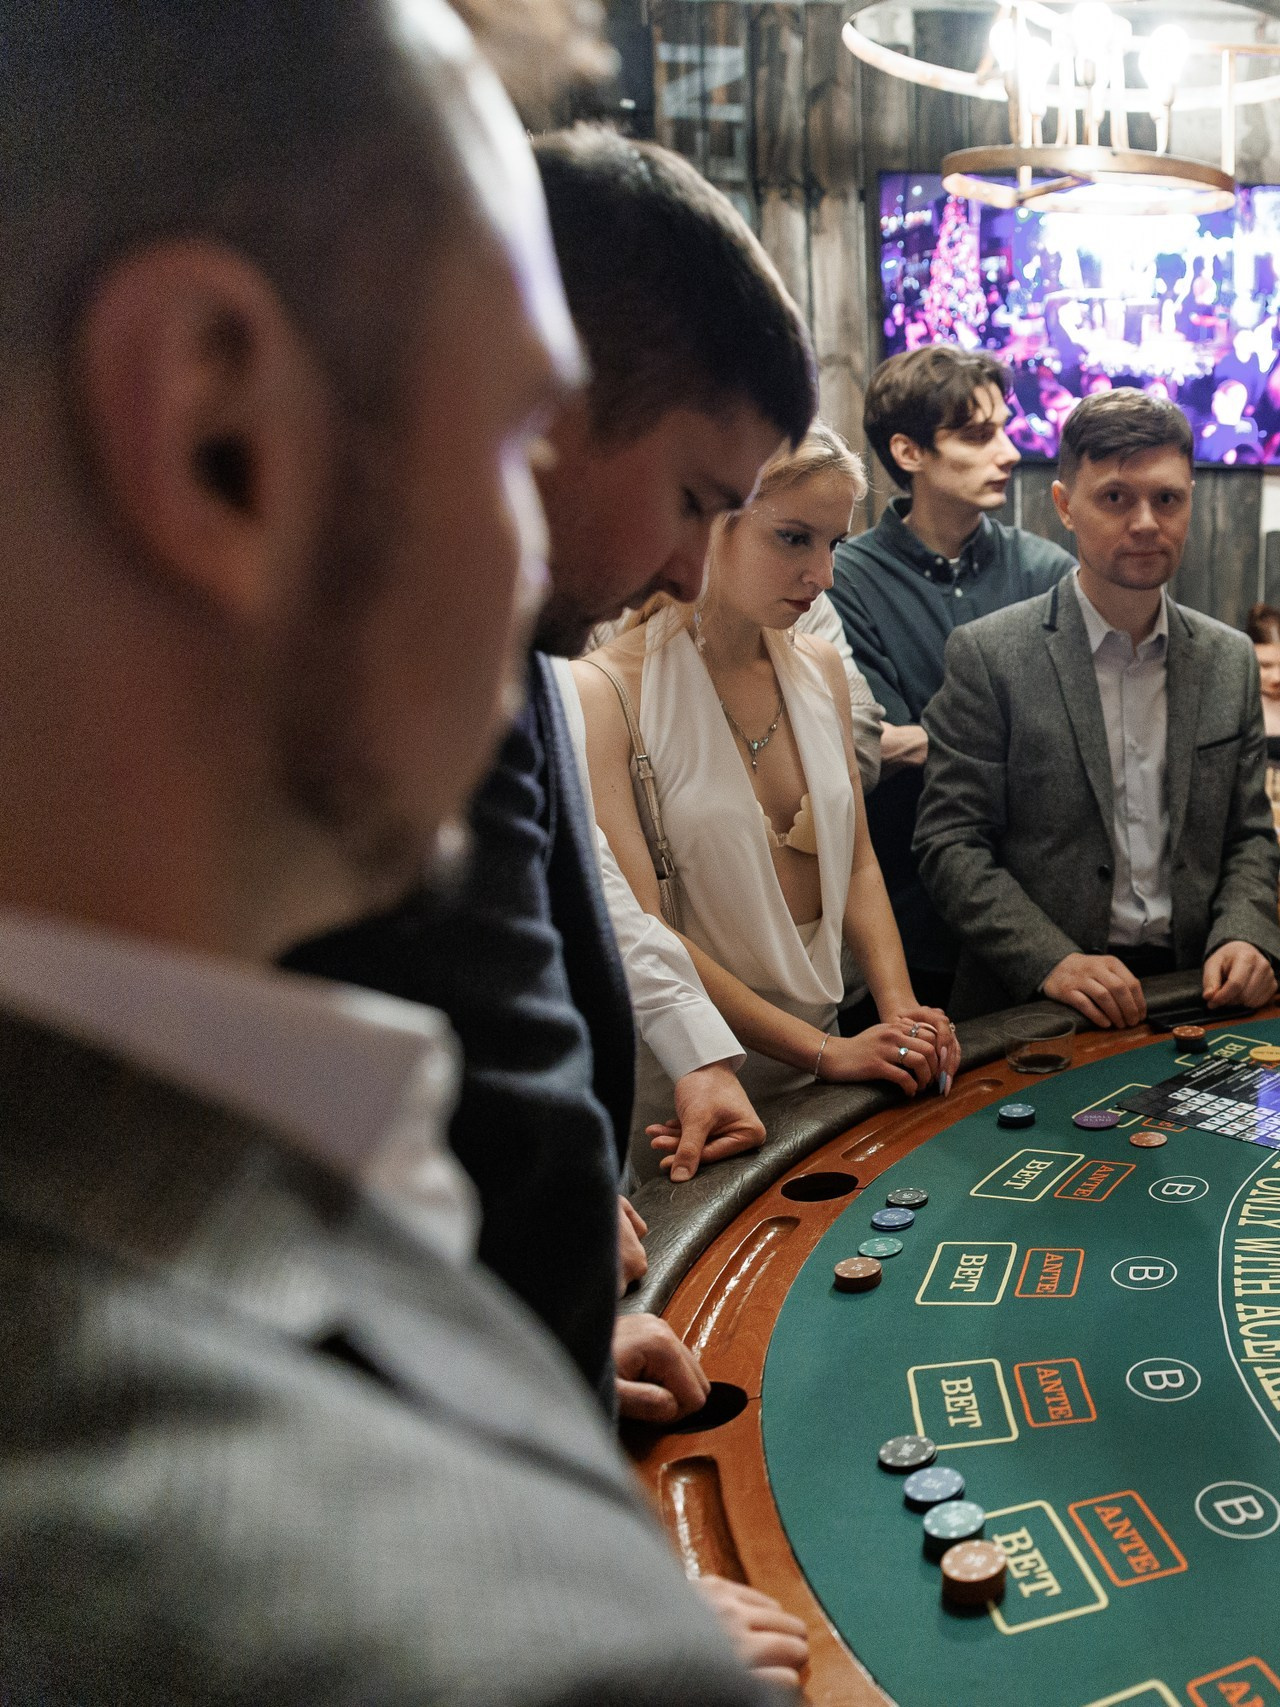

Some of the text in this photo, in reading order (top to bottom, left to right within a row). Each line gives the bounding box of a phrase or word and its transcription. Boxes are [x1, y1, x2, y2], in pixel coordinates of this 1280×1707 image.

[1204, 1043, 1248, 1059] BE
[1003, 1158, 1054, 1190] BET
[1072, 1164, 1116, 1197] ANTE
[1161, 1182, 1197, 1196] B
[948, 1253, 988, 1292] BET
[1035, 1252, 1064, 1294] ANTE
[1128, 1266, 1165, 1281] B
[1036, 1366, 1074, 1420] ANTE
[1143, 1369, 1185, 1391] B
[940, 1376, 983, 1428] BET
[1212, 1494, 1265, 1526] B
[1094, 1505, 1160, 1574] ANTE
[992, 1526, 1062, 1598] BET
